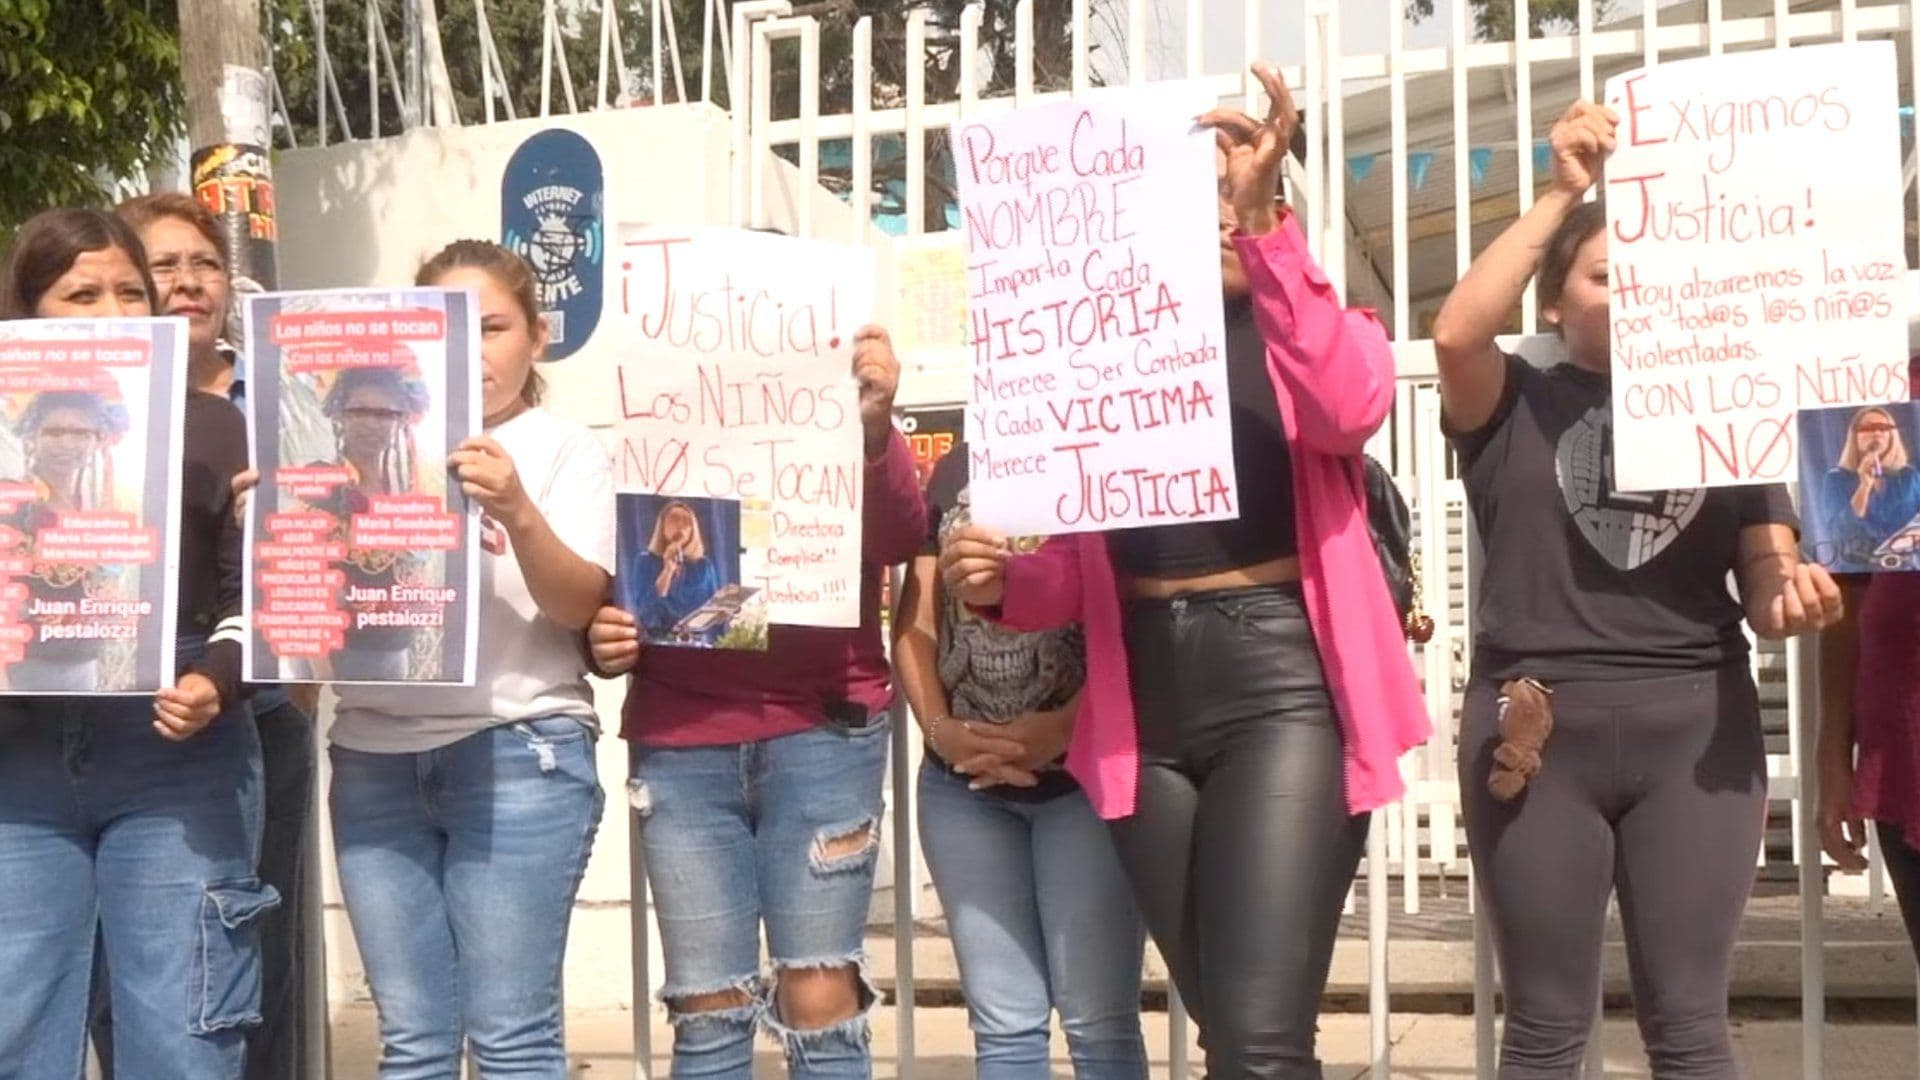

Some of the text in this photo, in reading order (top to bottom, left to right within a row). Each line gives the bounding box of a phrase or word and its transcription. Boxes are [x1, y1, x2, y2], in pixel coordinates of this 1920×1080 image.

[961, 110, 1145, 197] Porque Cada
[522, 184, 585, 210] INTERNET
[965, 176, 1142, 252] NOMBRE
[1609, 172, 1815, 244] Justicia!
[534, 274, 583, 304] ENTE
[620, 237, 841, 358] ¡Justicia!
[967, 248, 1072, 298] Importa
[1082, 247, 1152, 292] Cada
[1612, 248, 1898, 316] Hoy alzaremos la voz
[275, 319, 438, 338] Los niños no se tocan
[970, 282, 1182, 365] HISTORIA
[1613, 313, 1654, 348] por
[44, 350, 67, 361] no
[71, 350, 91, 361] se
[95, 349, 143, 361] tocan
[335, 347, 369, 363] niños
[973, 333, 1218, 404] Merece Ser Contada
[697, 363, 844, 431] NIÑOS
[973, 379, 1214, 441] Y Cada VICTIMA
[1624, 353, 1909, 420] CON LOS NIÑOS
[972, 442, 1231, 526] Merece JUSTICIA
[772, 511, 844, 538] Directora
[28, 598, 75, 615] Juan
[80, 598, 152, 617] Enrique
[345, 586, 456, 605] Juan Enrique
[356, 609, 444, 629] pestalozzi
[40, 622, 137, 642] pestalozzi
